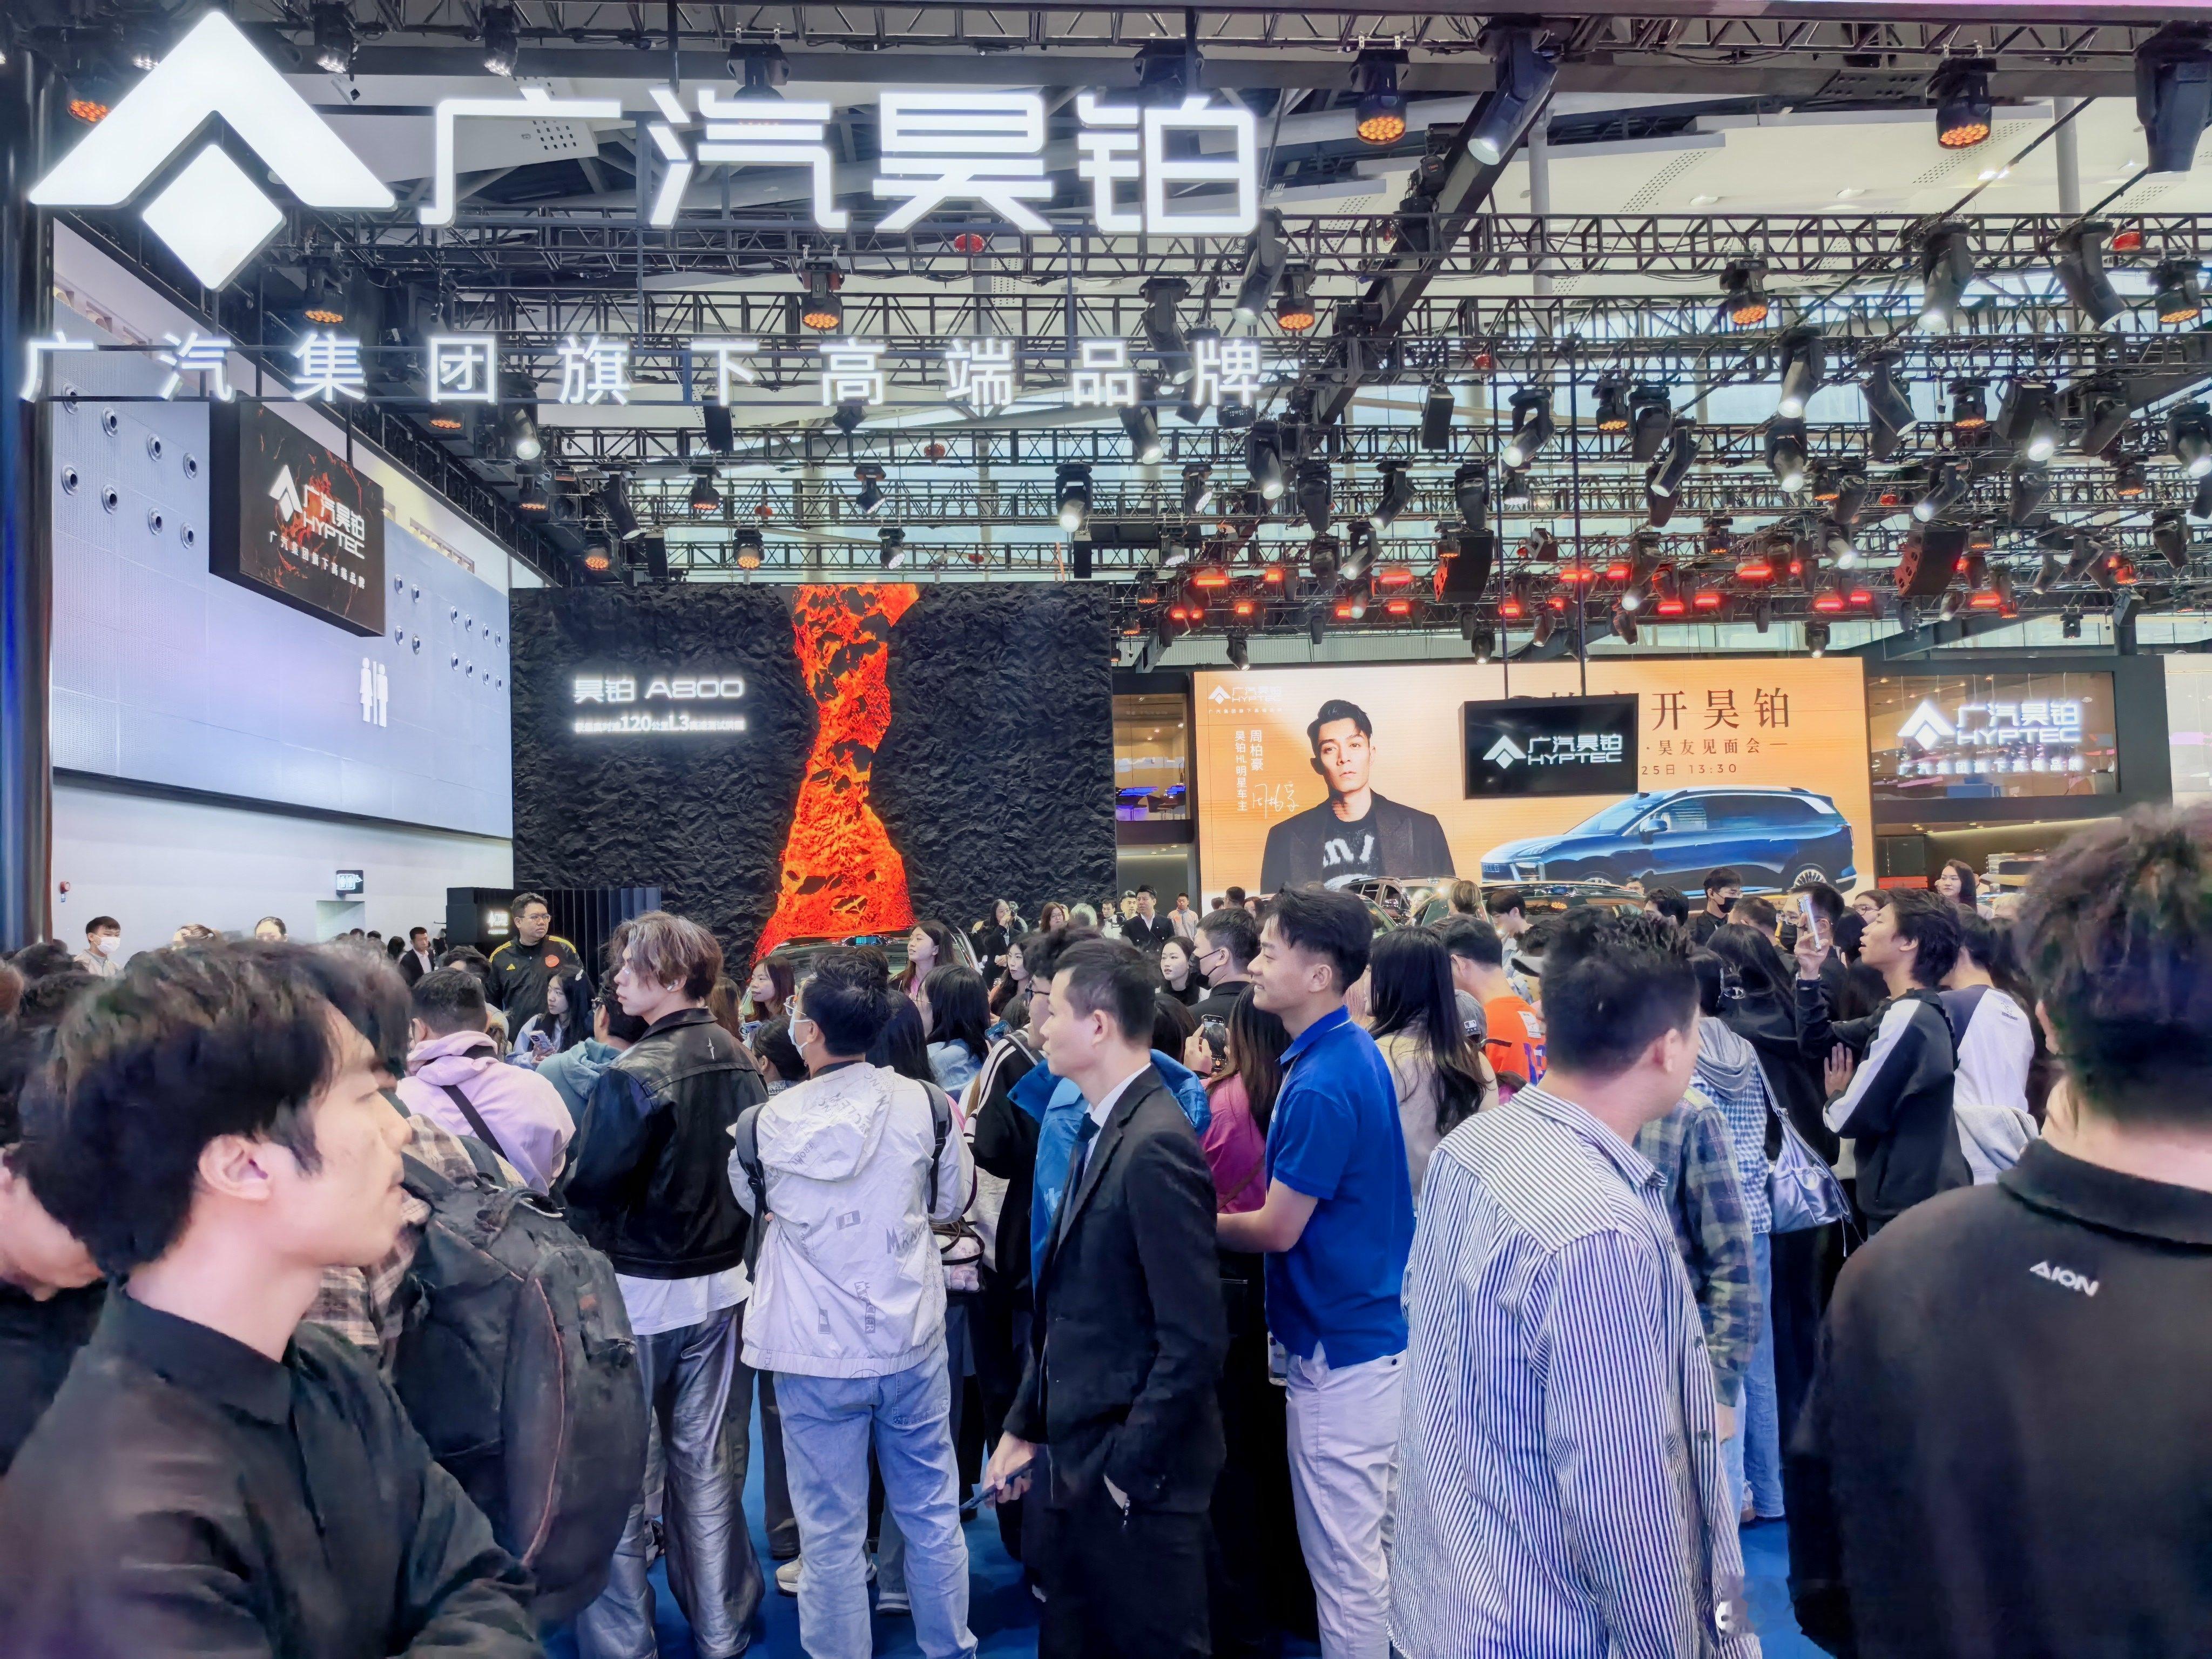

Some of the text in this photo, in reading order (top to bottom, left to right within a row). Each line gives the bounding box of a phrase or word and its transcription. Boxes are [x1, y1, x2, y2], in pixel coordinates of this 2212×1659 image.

[420, 89, 1257, 234] 广汽昊铂
[21, 332, 1260, 405] 广汽集团旗下高端品牌
[302, 484, 365, 541] 广汽昊铂
[304, 511, 365, 559] HYPTEC
[575, 679, 744, 703] 昊铂 A800
[1956, 702, 2079, 726] 广汽昊铂
[1250, 730, 1264, 771] 周柏豪
[1528, 734, 1623, 753] 广汽昊铂
[1957, 727, 2081, 745] HYPTEC
[1235, 730, 1248, 811] 昊铂HL明星车主
[1528, 752, 1623, 765] HYPTEC
[1641, 763, 1737, 775] 25日 13:30
[2029, 1261, 2099, 1296] AION
